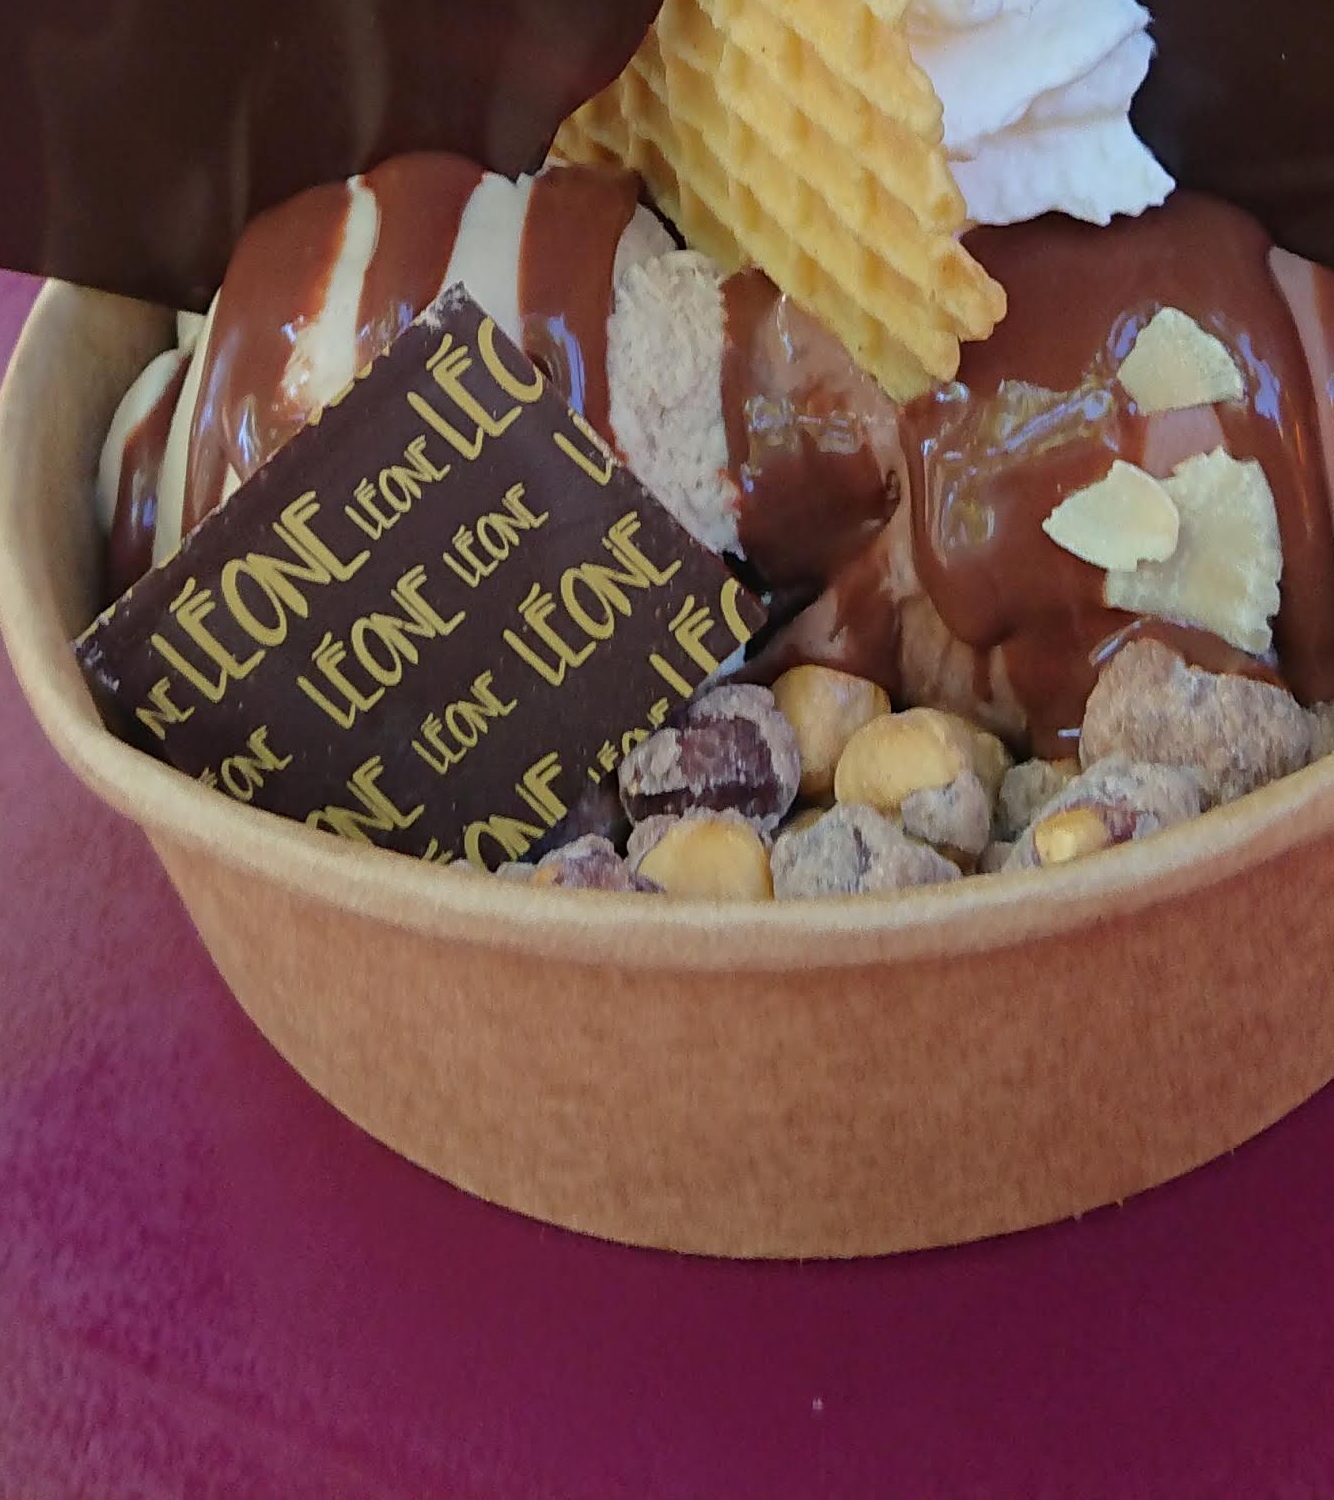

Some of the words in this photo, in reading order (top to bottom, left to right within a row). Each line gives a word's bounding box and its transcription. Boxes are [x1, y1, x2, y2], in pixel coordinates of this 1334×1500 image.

[150, 491, 371, 703] LÉONE
[344, 435, 451, 541] LÉONE
[296, 565, 466, 730] LÉONE
[442, 483, 549, 588] LÉONE
[411, 670, 518, 775] LÉONE
[503, 511, 683, 687] LÉONE
